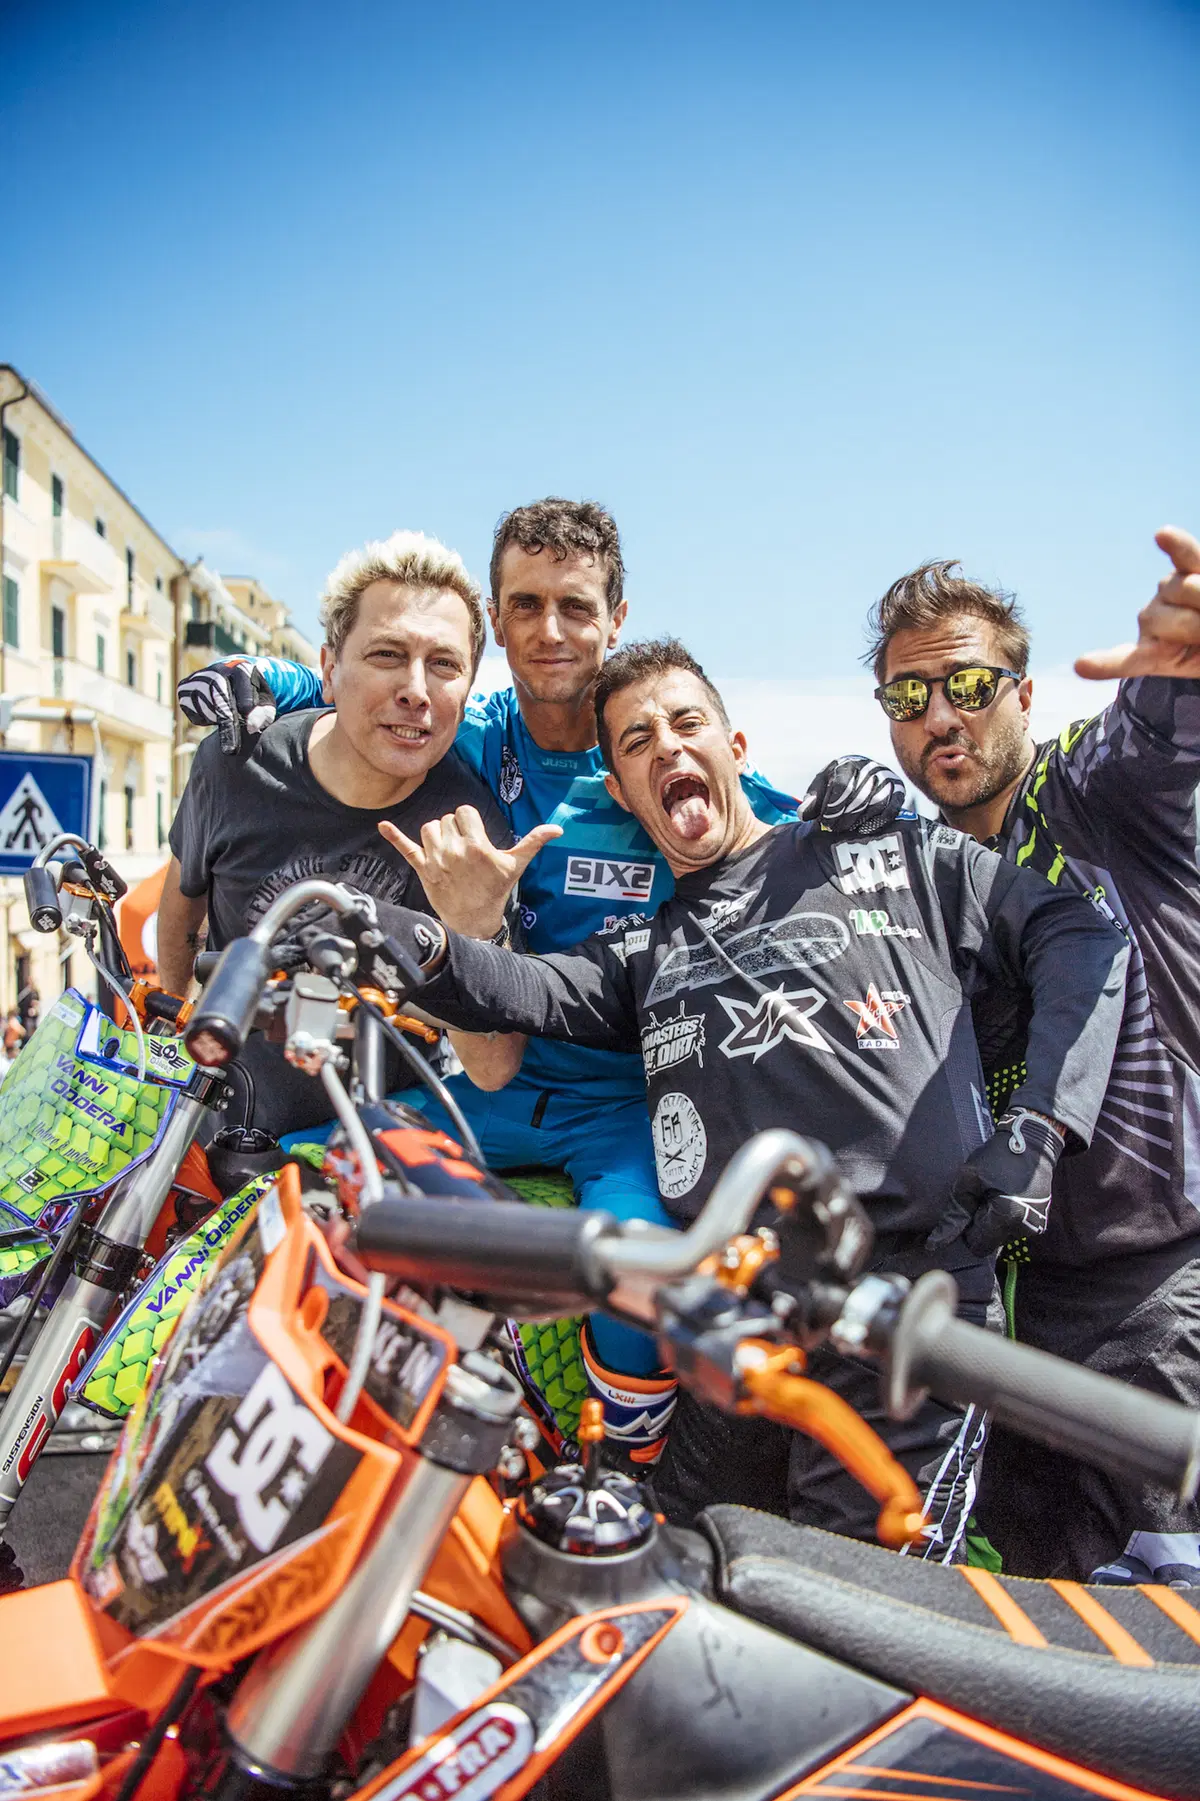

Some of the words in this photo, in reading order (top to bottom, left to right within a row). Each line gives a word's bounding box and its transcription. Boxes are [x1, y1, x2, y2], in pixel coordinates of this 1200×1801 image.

[643, 1019, 700, 1052] MASTERS
[645, 1048, 656, 1063] OF
[656, 1031, 698, 1067] DIRT
[859, 1040, 899, 1048] RADIO
[56, 1053, 109, 1096] VANNI
[50, 1078, 127, 1137] ODDERA
[145, 1245, 210, 1314] VANNI
[204, 1187, 267, 1248] ODDERA
[2, 1395, 44, 1474] SUSPENSION
